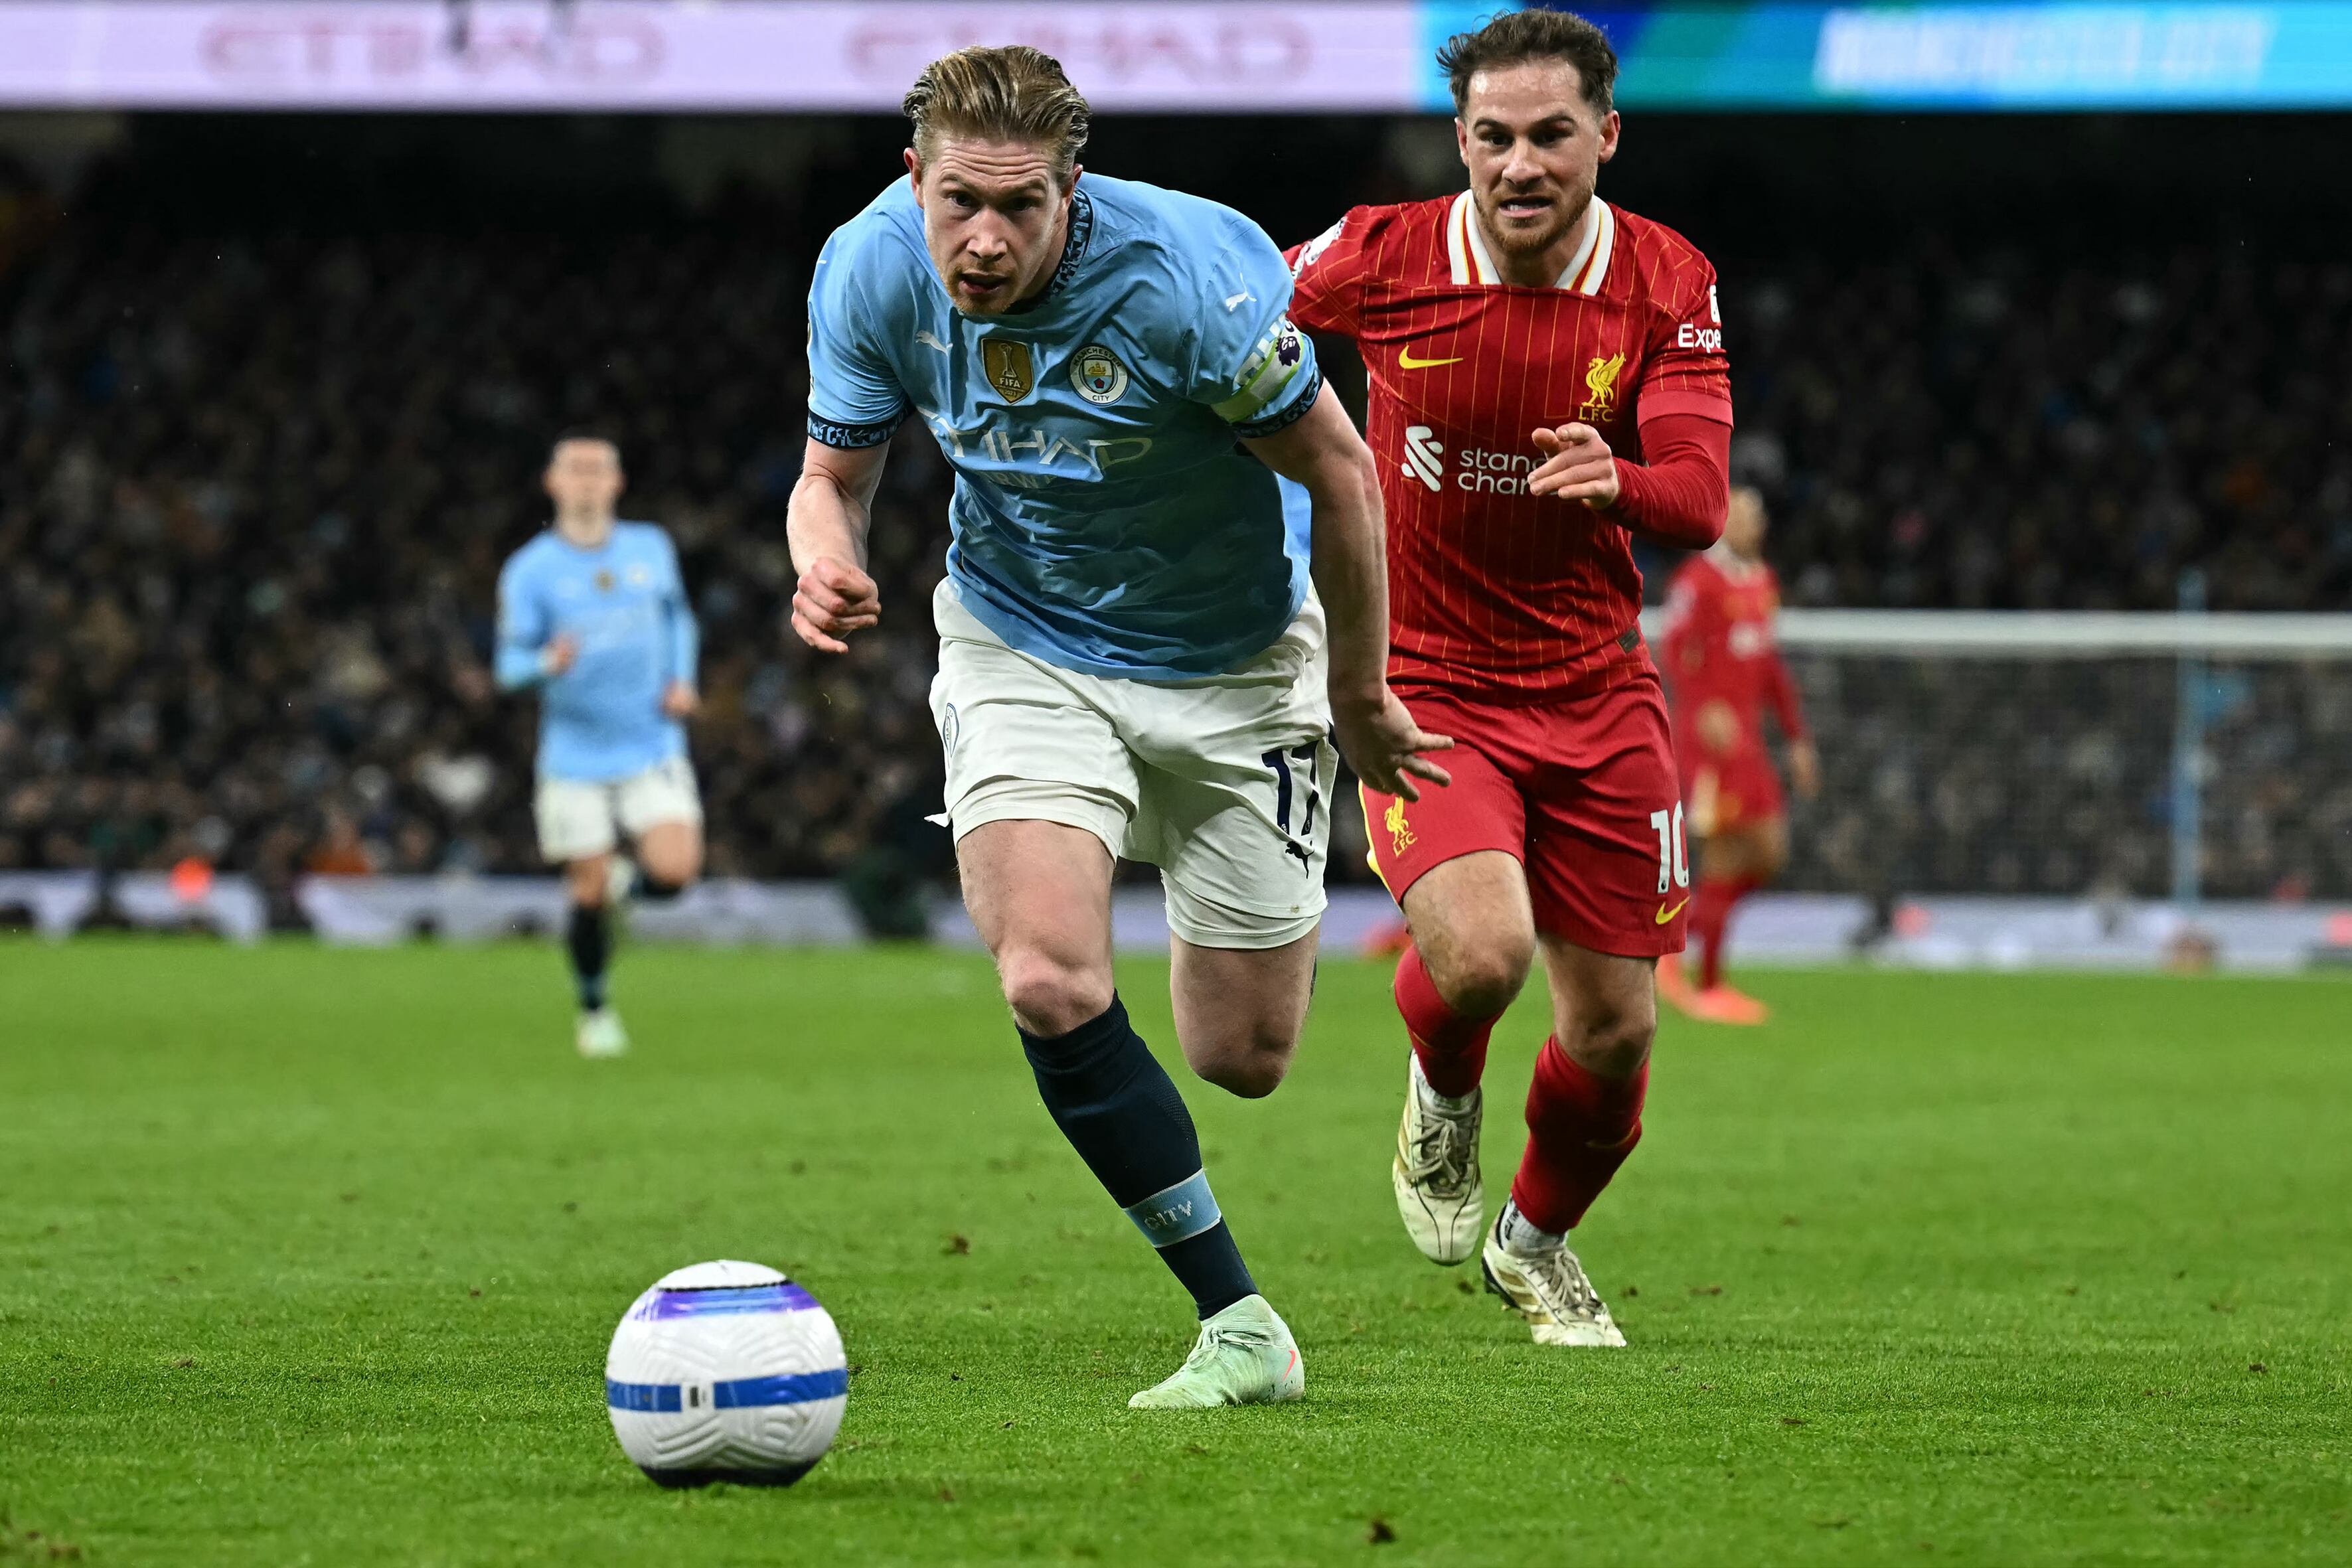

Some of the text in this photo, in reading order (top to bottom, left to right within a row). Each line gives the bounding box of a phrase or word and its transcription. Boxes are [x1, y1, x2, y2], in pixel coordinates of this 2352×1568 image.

[999, 377, 1021, 388] FIFA
[1073, 347, 1122, 367] MANCHESTER
[1261, 740, 1320, 836] 17
[1650, 800, 1689, 894] 10
